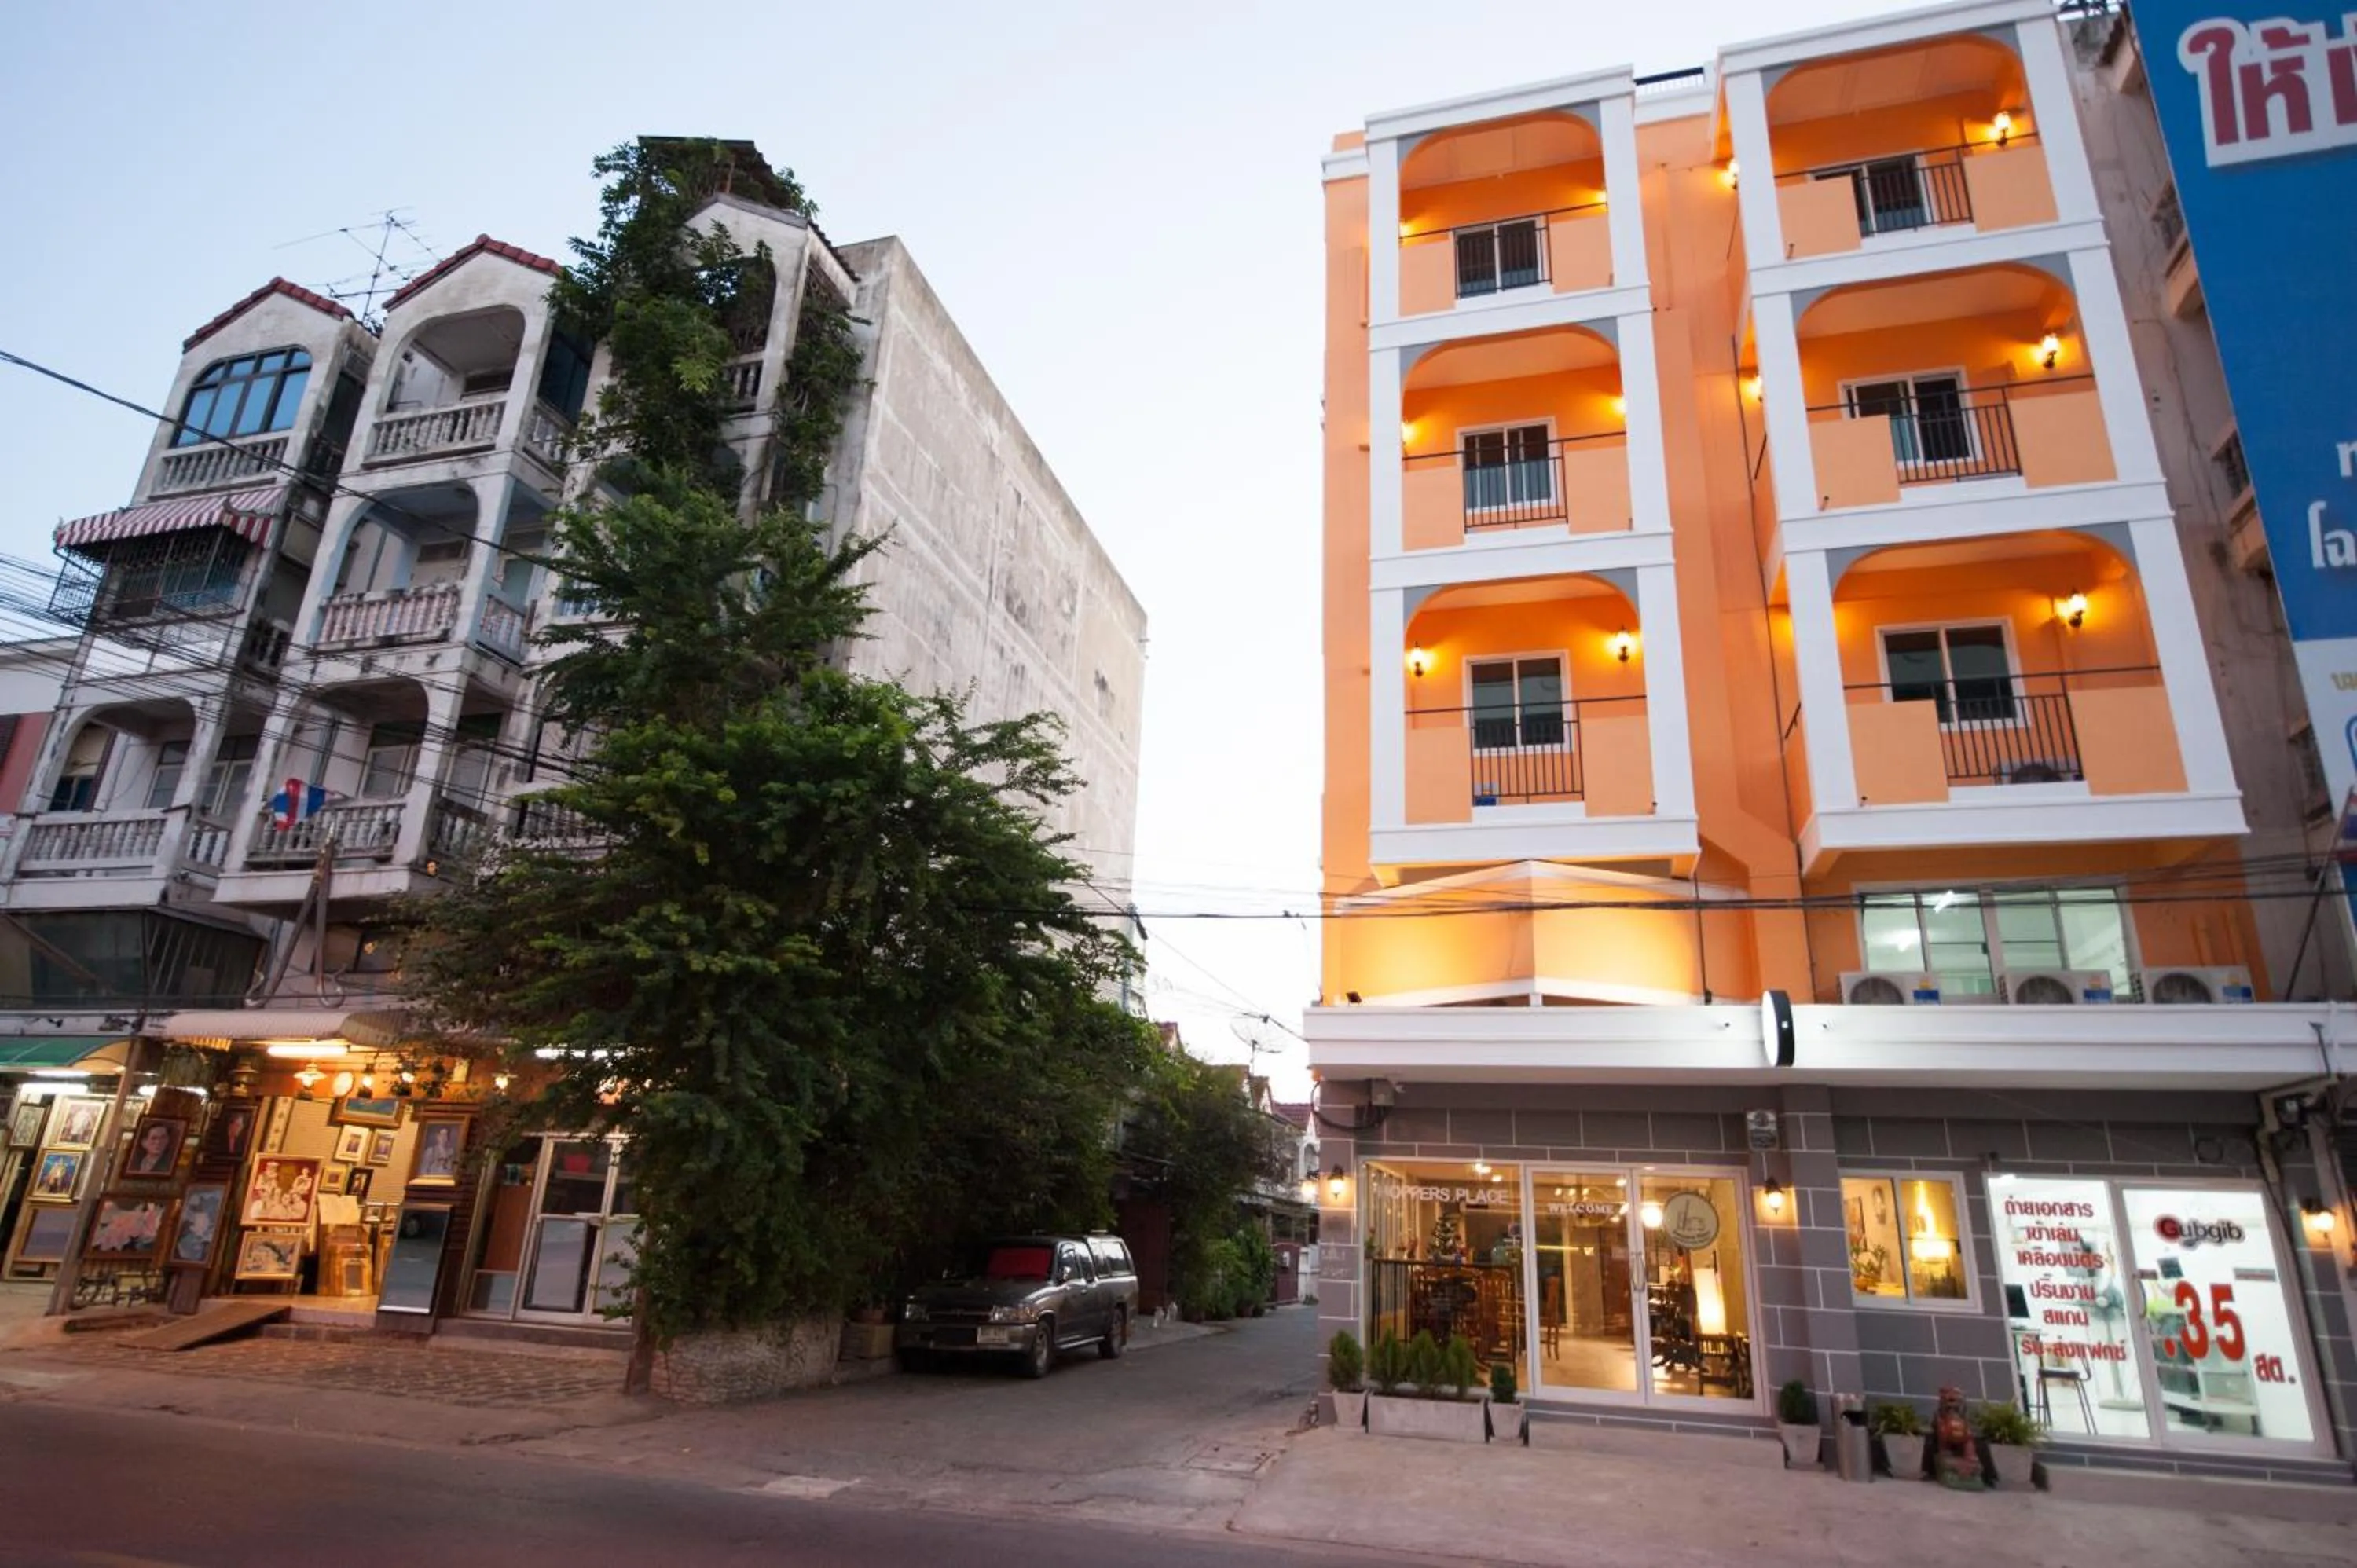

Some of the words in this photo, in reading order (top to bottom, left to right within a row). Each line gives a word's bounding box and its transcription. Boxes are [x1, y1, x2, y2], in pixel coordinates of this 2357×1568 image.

[1455, 1188, 1508, 1204] PLACE
[1547, 1203, 1614, 1214] WELCOME
[2004, 1195, 2094, 1218] ถ่ายเอกสาร
[2155, 1214, 2243, 1246] Gubgib
[2044, 1309, 2088, 1326] สแกน
